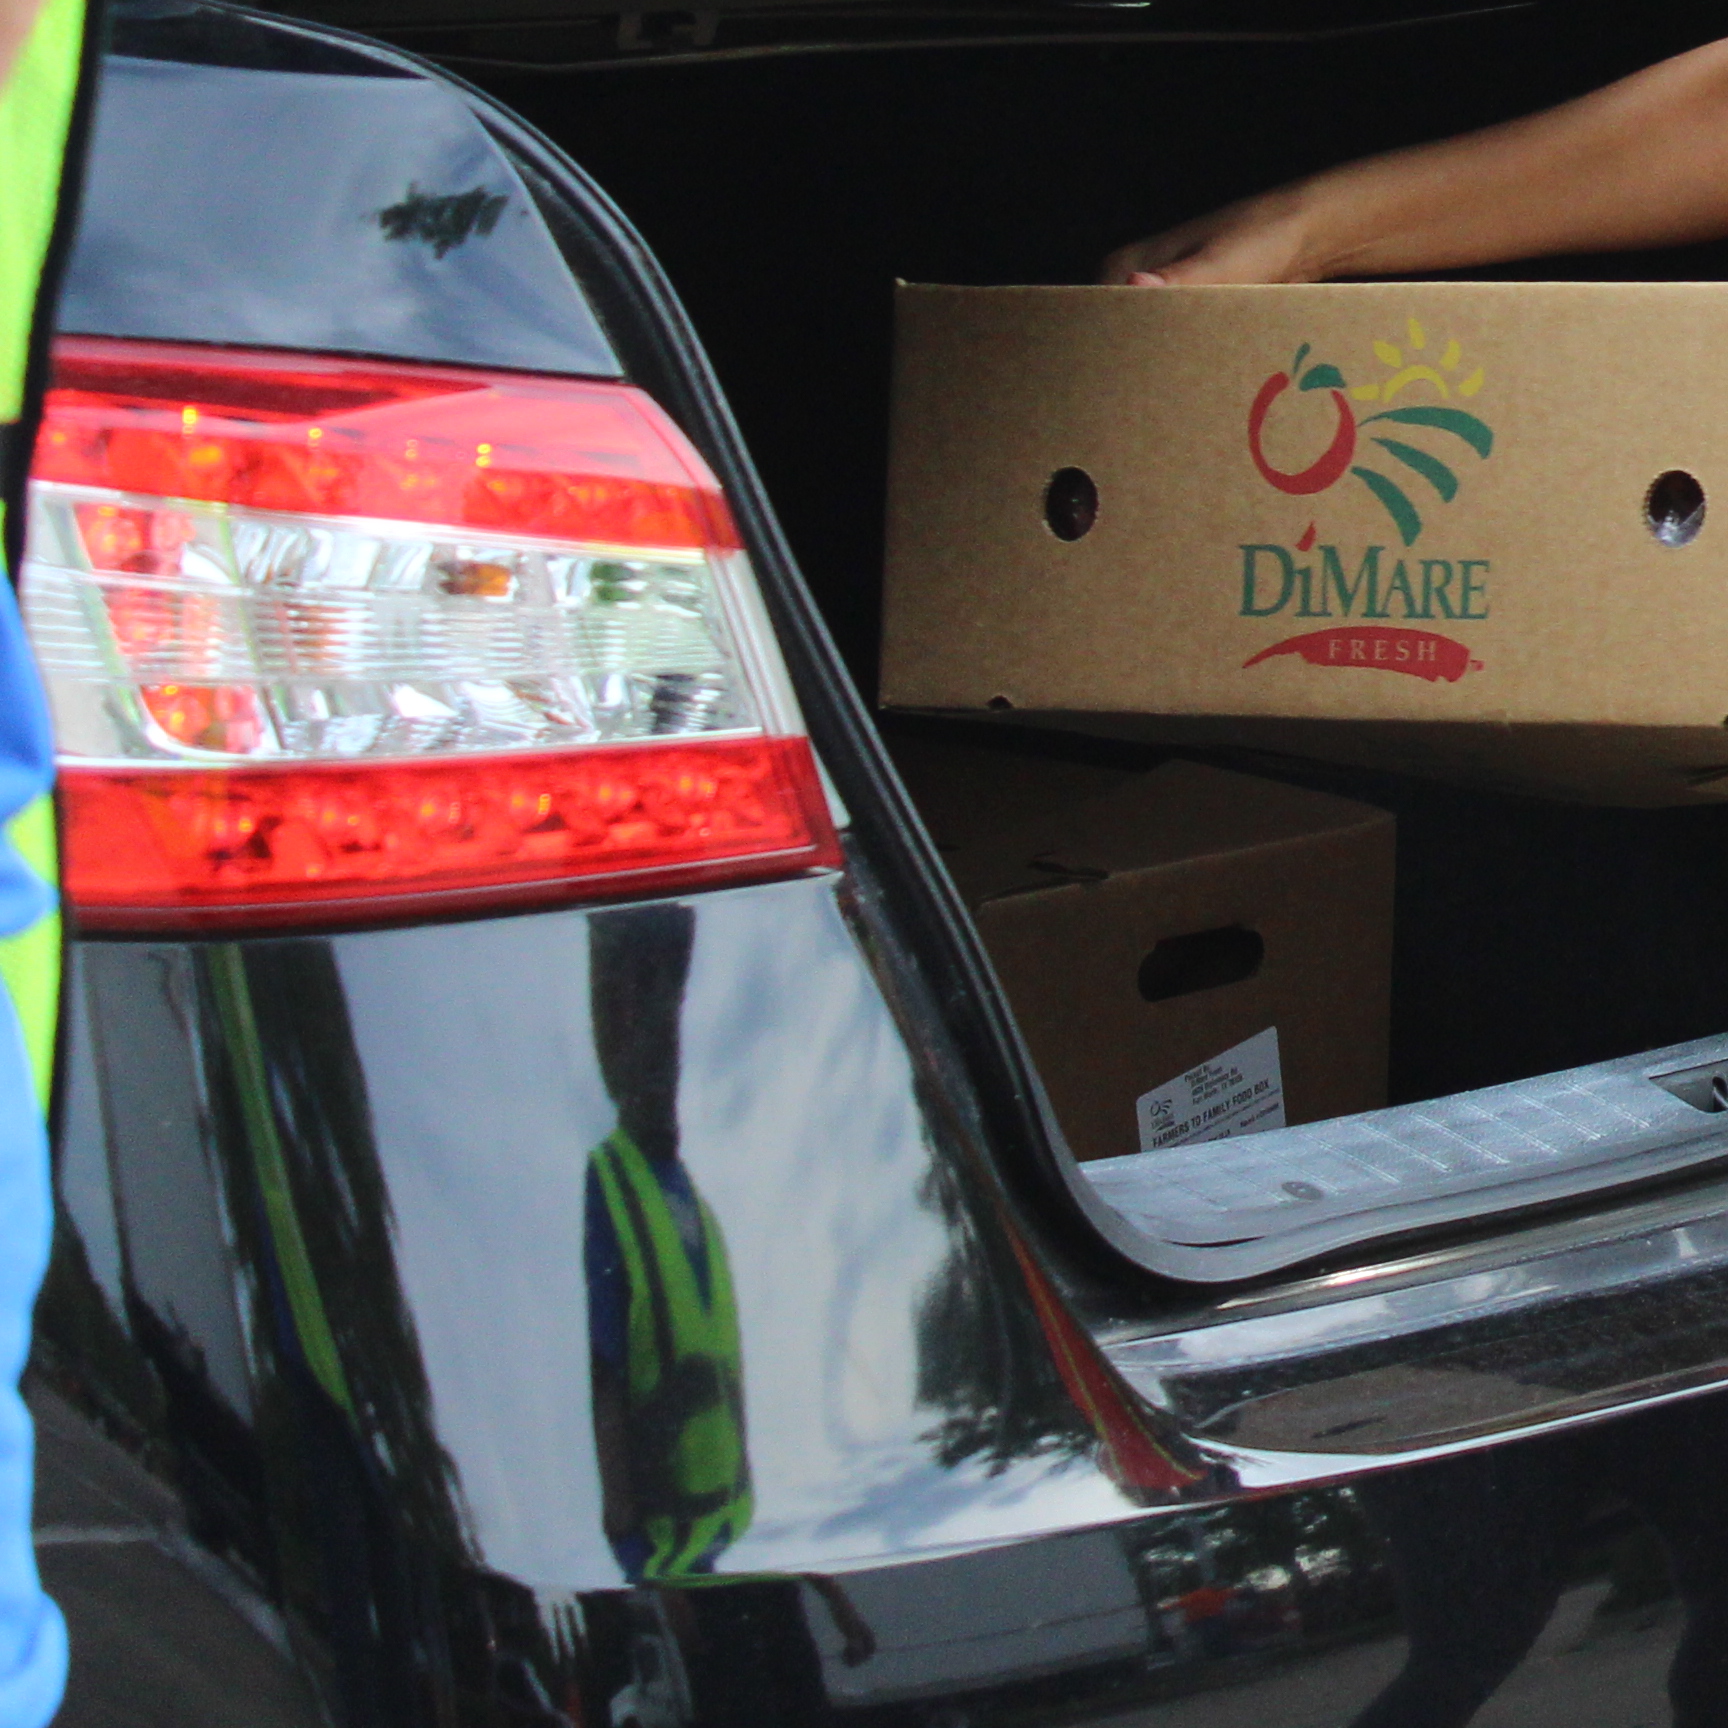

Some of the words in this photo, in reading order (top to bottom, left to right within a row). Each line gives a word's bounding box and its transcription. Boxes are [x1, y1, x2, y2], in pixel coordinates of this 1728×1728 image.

[1329, 639, 1437, 662] FRESH
[1152, 1121, 1190, 1148] FARMERS
[1202, 1099, 1231, 1124] FAMILY
[1232, 1087, 1253, 1106] FOOD
[1253, 1078, 1270, 1095] BOX
